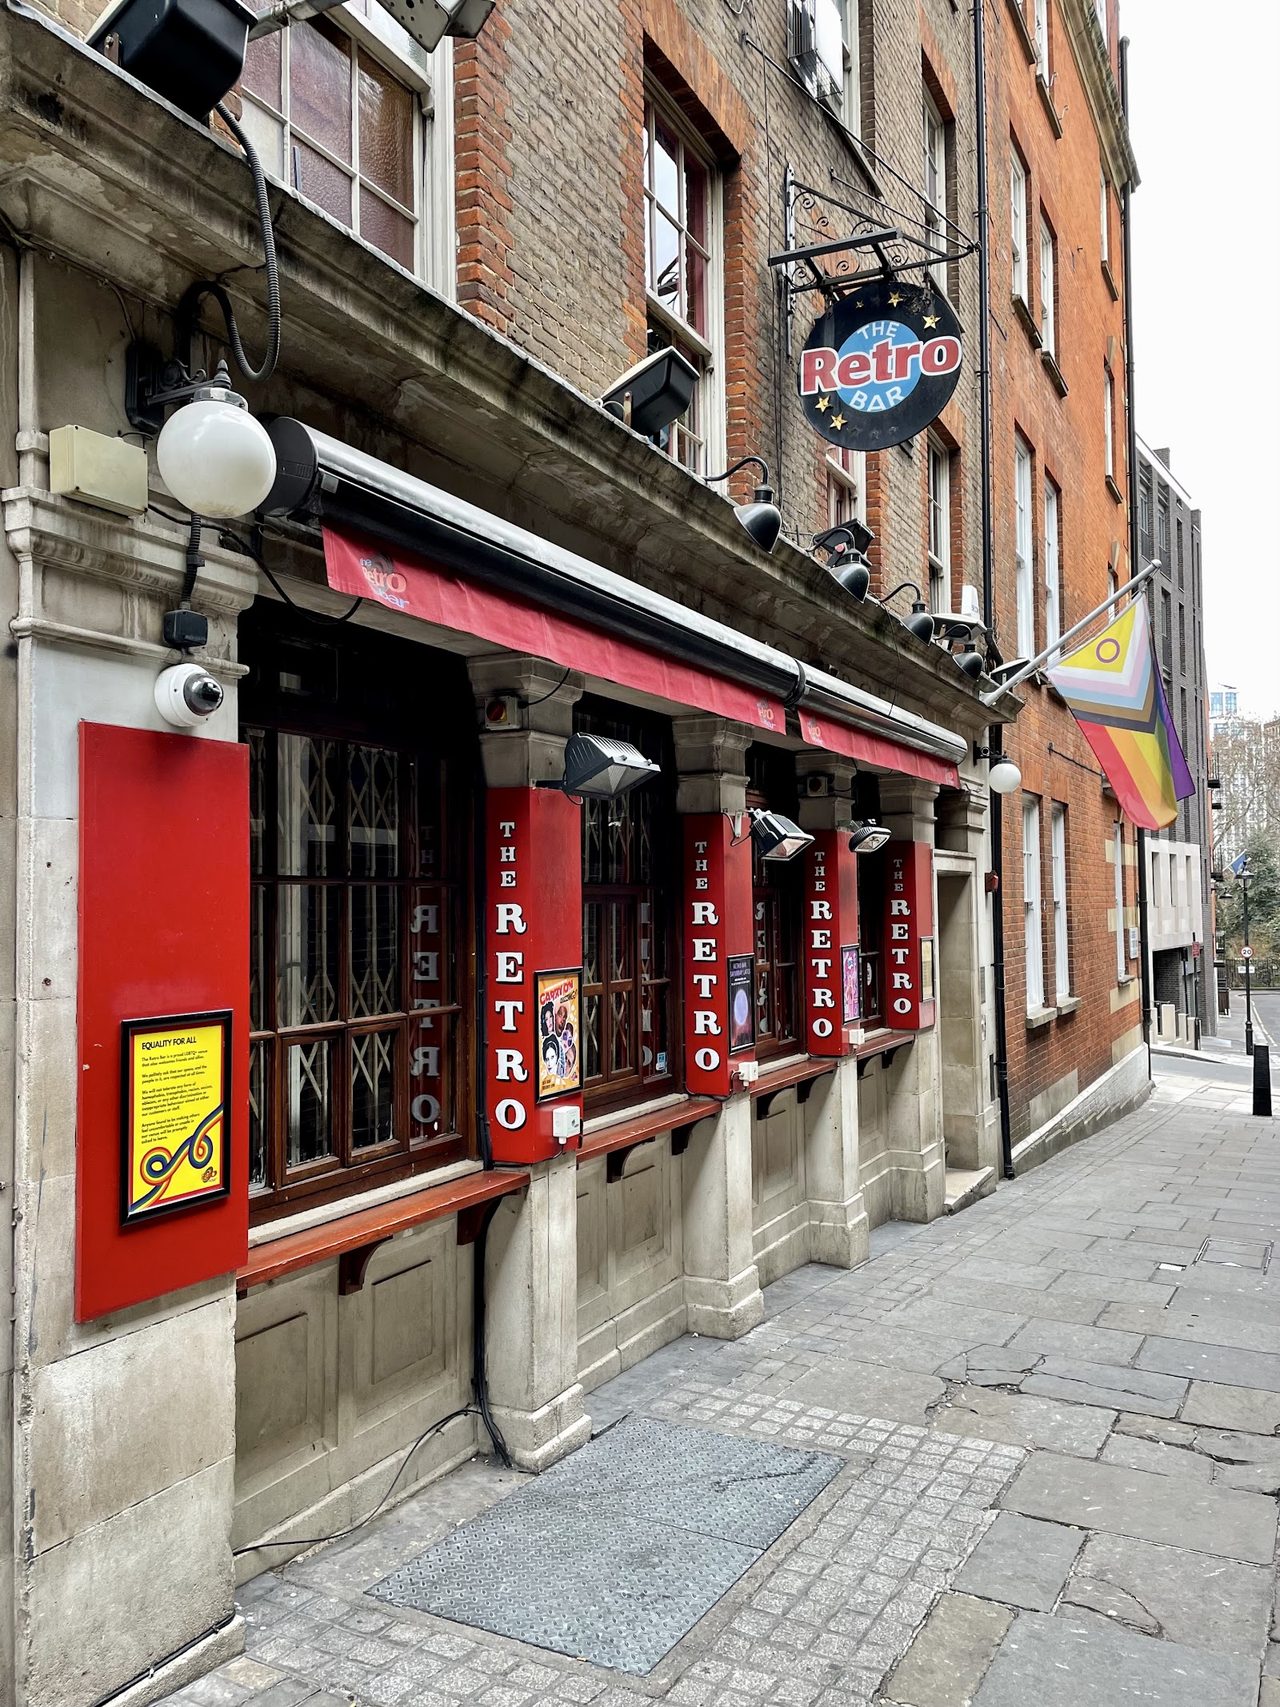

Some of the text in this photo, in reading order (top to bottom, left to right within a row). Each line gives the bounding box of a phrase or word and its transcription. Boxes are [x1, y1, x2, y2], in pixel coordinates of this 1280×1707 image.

[800, 336, 963, 395] Retro
[857, 321, 900, 339] THE
[849, 386, 905, 412] BAR
[495, 821, 527, 1131] THE RETRO
[692, 841, 722, 1071] THE RETRO
[810, 851, 835, 1038] THE RETRO
[890, 859, 913, 1014] THE RETRO
[141, 1036, 197, 1051] EQUALITY FOR ALL
